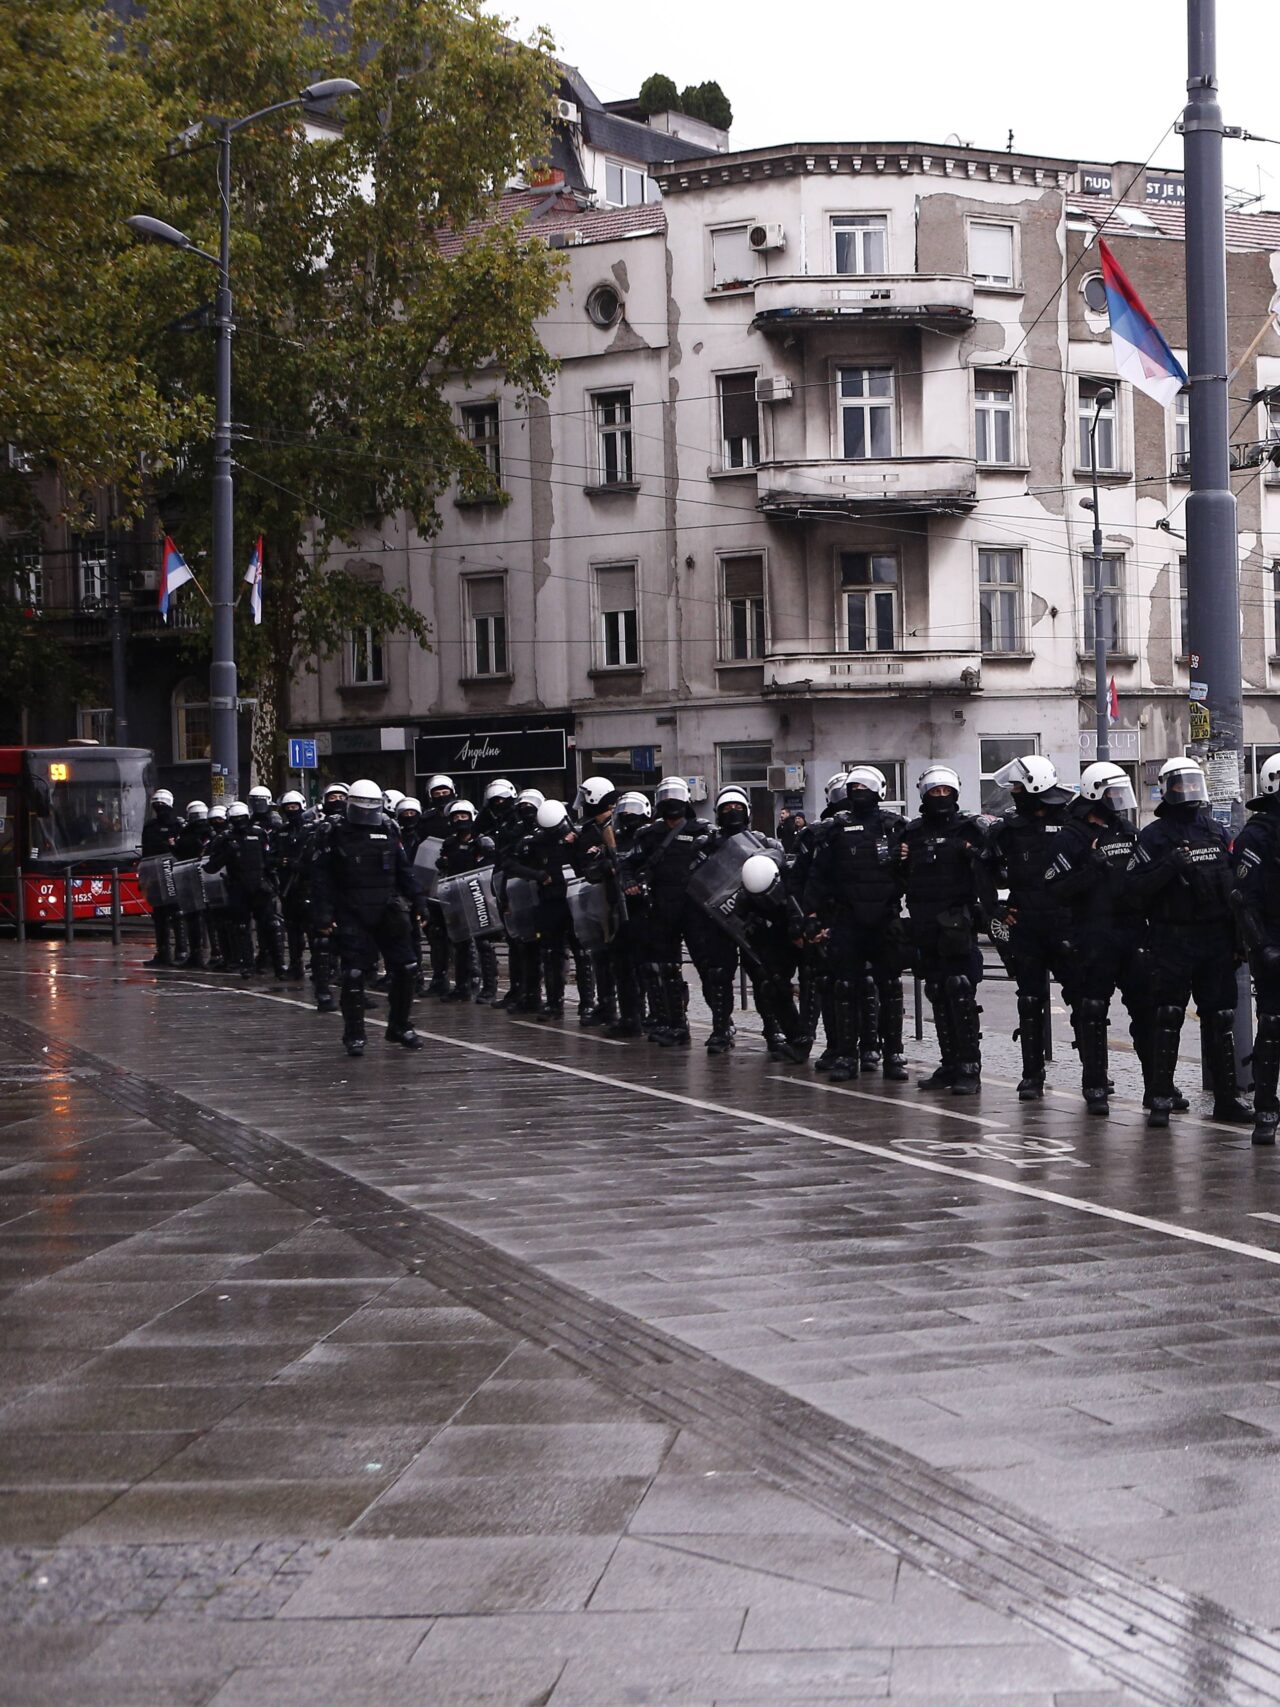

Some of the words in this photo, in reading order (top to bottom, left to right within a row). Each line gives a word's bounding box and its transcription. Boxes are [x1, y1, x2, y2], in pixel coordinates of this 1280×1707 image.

[1162, 183, 1174, 197] JE
[454, 737, 501, 769] Angolino
[50, 764, 67, 781] 59
[1192, 853, 1217, 862] БРИГАДА
[40, 884, 54, 894] 07
[469, 879, 489, 928] ПОЛИЦИЈА
